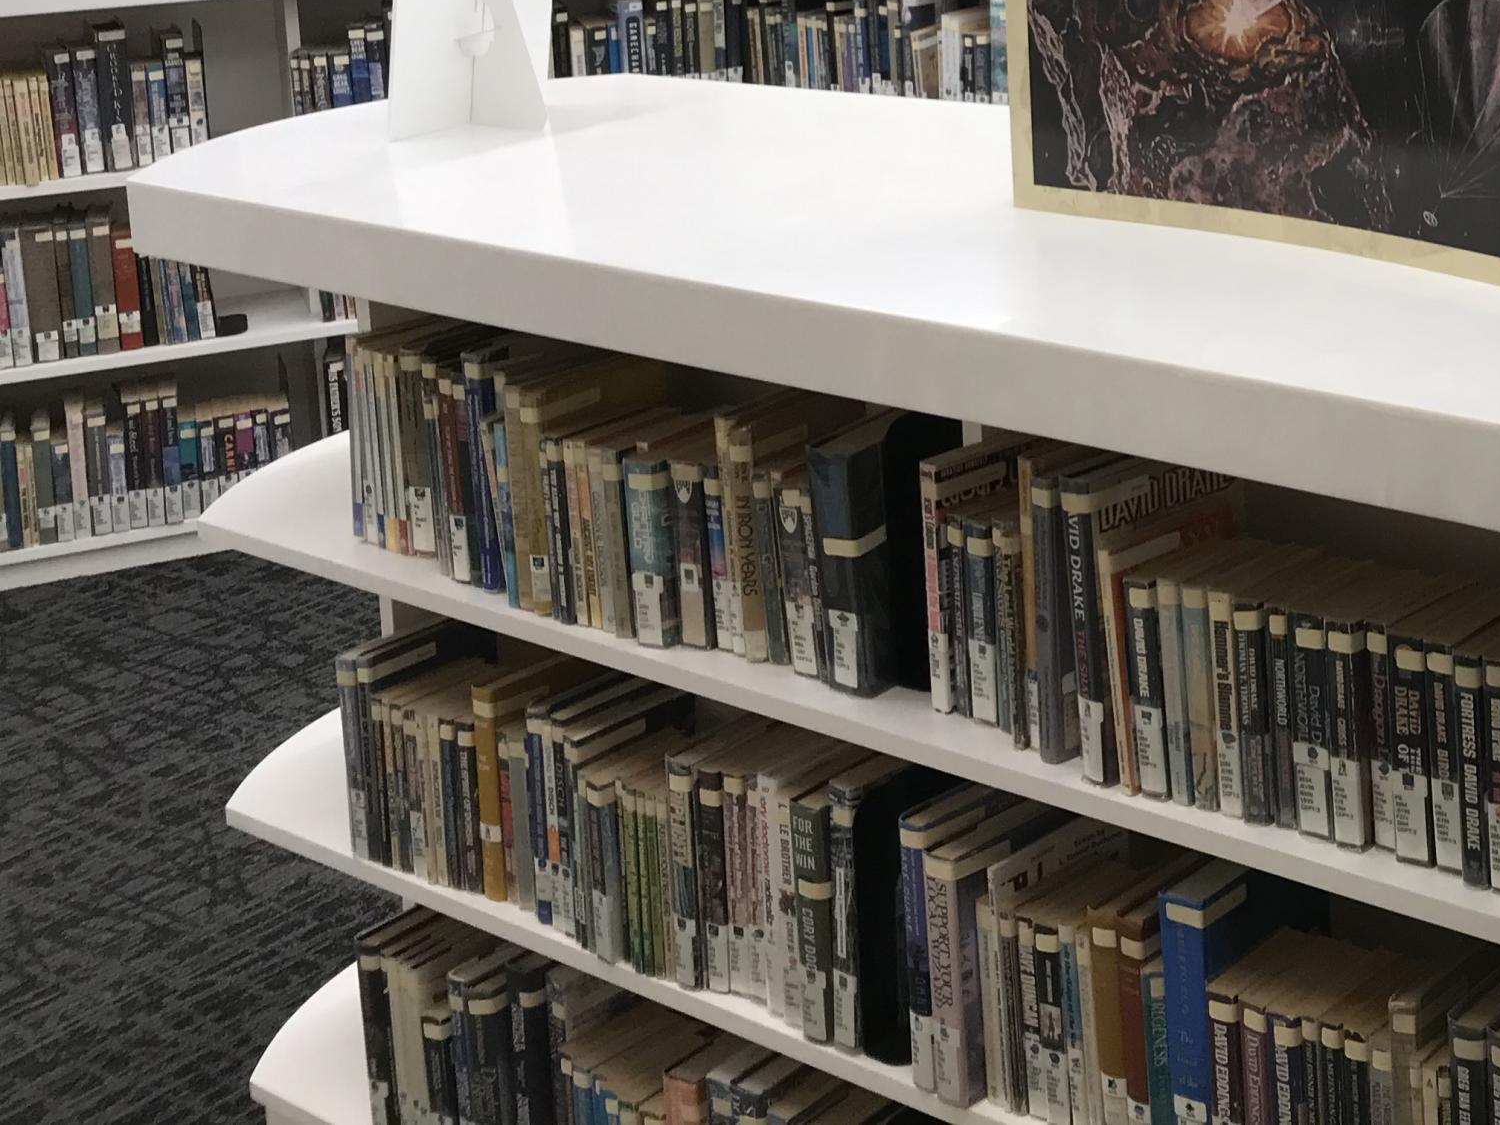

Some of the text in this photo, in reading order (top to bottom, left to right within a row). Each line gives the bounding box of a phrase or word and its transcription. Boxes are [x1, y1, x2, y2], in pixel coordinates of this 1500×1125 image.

[741, 552, 758, 596] YEARS
[1070, 555, 1085, 622] DRAKE
[1217, 682, 1232, 731] Slamme
[1460, 692, 1481, 851] FORTRESS DAVID DRAKE
[792, 815, 813, 835] FOR
[794, 834, 813, 852] THE
[795, 855, 815, 871] WIN
